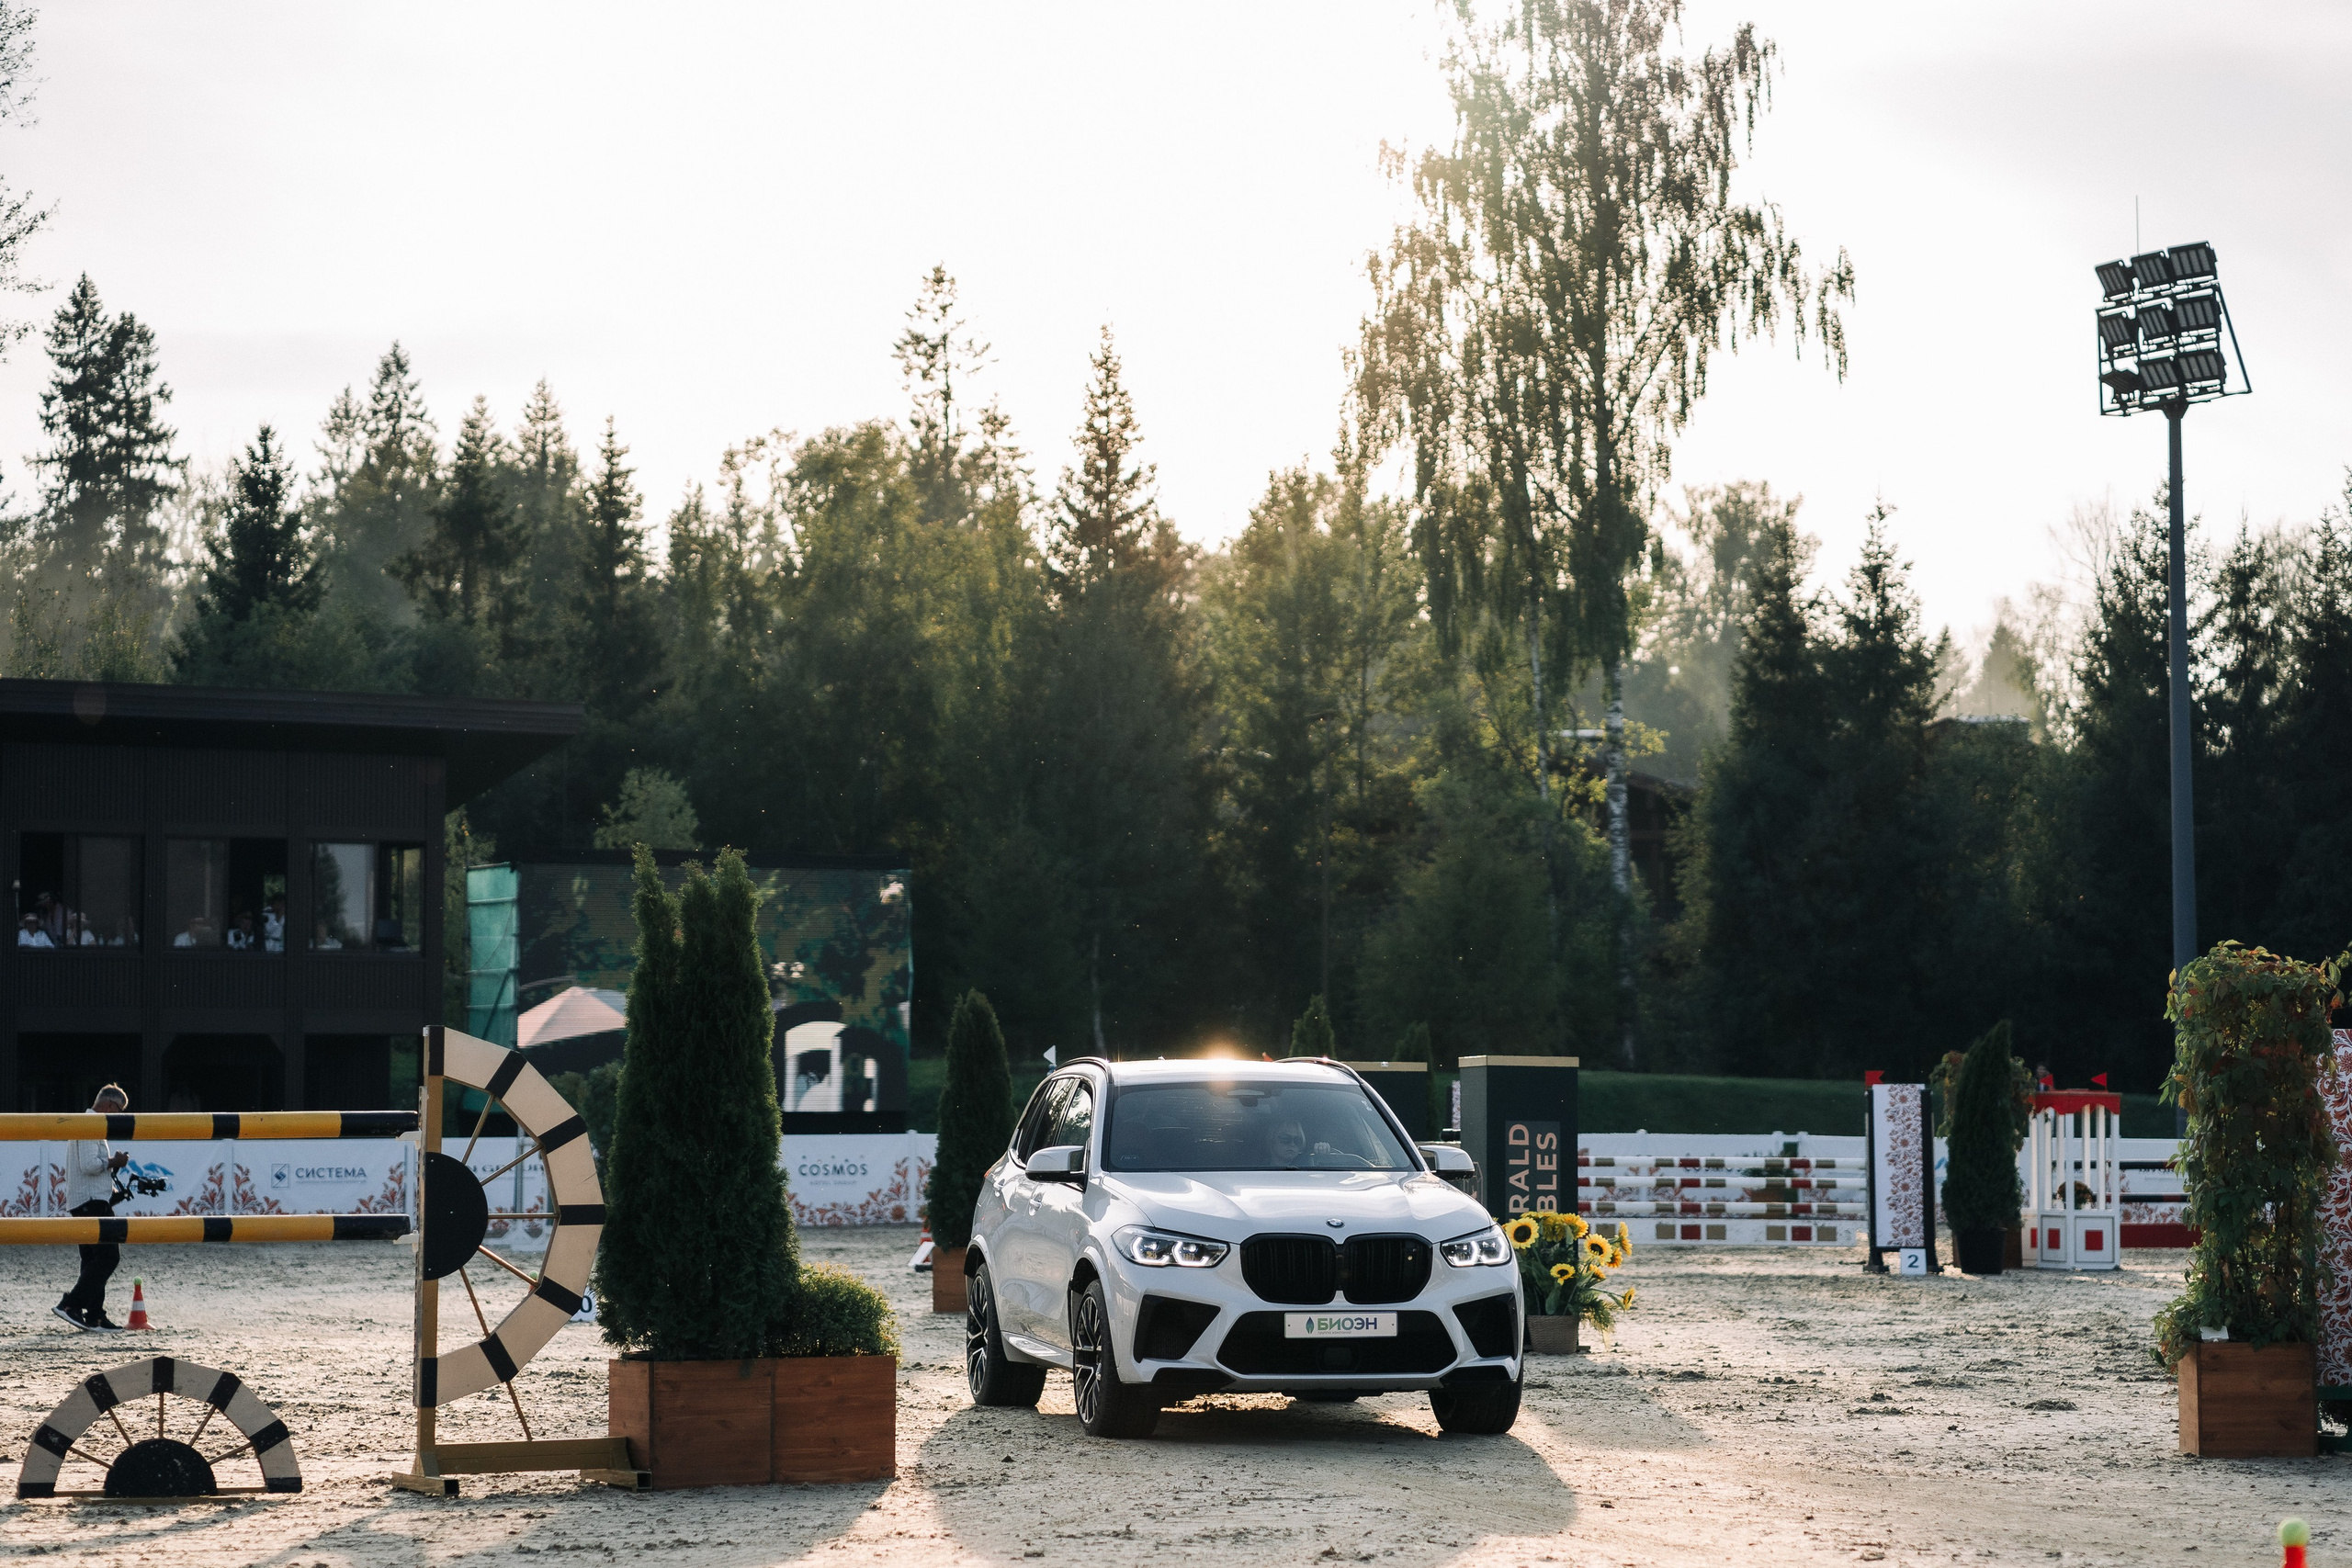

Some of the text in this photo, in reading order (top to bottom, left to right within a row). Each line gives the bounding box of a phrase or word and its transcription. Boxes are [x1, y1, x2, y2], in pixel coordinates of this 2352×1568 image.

[295, 1167, 367, 1179] СИСТЕМА
[798, 1163, 868, 1176] COSMOS
[1907, 1254, 1919, 1269] 2
[1317, 1318, 1377, 1331] БИОЭН
